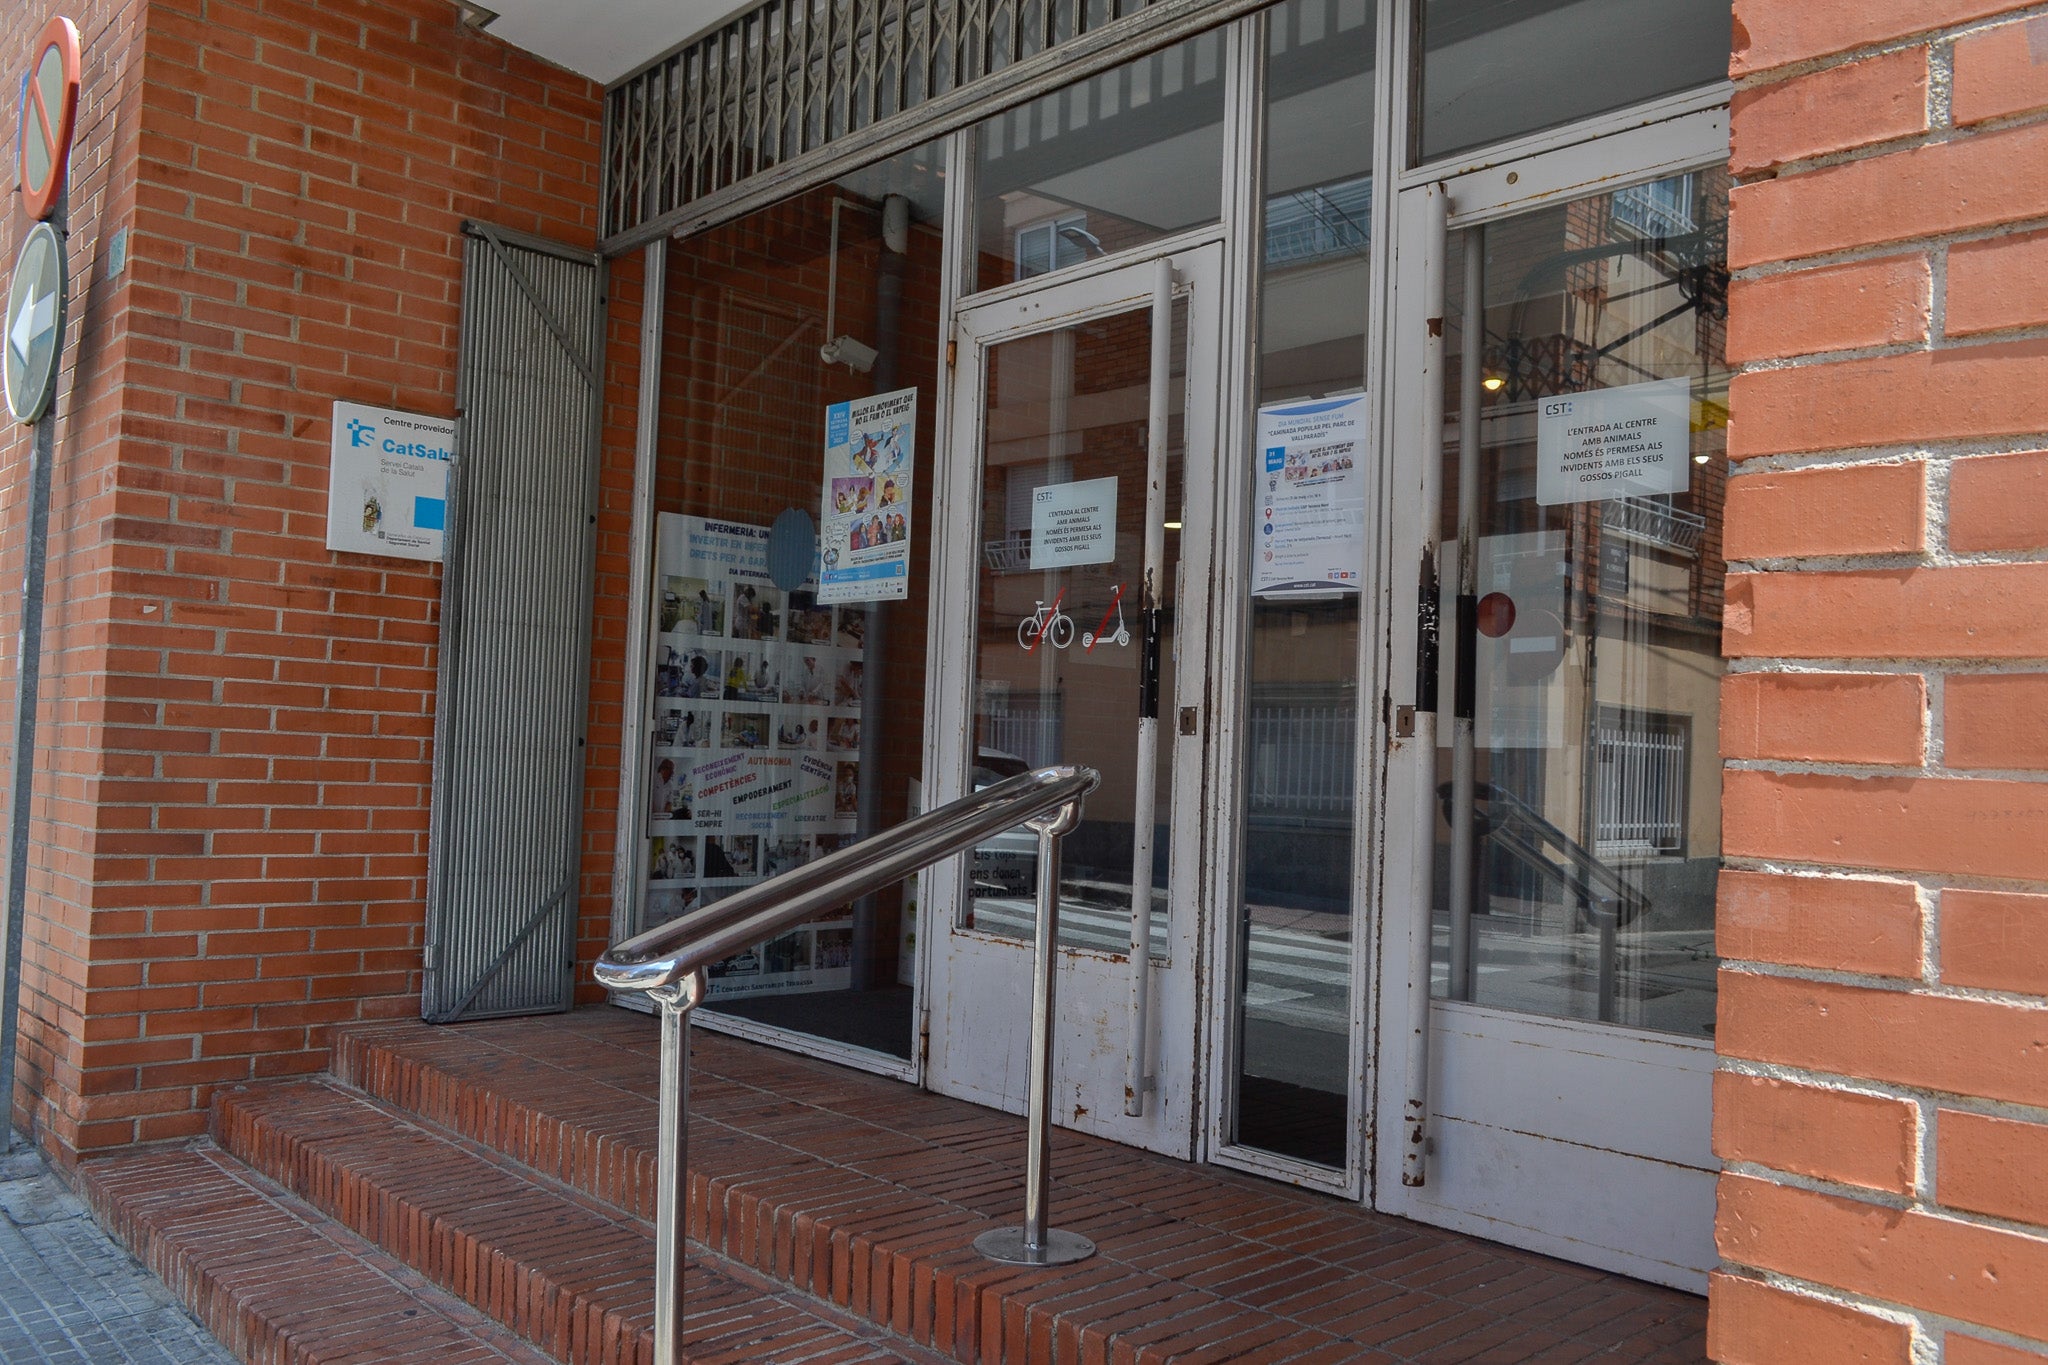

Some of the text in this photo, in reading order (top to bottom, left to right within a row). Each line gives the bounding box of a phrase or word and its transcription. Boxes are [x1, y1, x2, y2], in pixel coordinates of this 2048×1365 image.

[383, 416, 454, 435] Centre proveïdor
[1297, 423, 1321, 432] POPULAR
[1613, 422, 1624, 431] AL
[1625, 417, 1657, 429] CENTRE
[1582, 431, 1642, 447] AMB ANIMALS
[1563, 441, 1663, 461] NOMÉS ÉS PERMESA ALS
[380, 458, 402, 468] Servei
[1560, 453, 1664, 473] INVIDENTS AMB ELS SEUS
[398, 468, 416, 477] Salut
[1579, 468, 1643, 482] GOSSOS PIGALL
[1081, 505, 1099, 514] CENTRE
[1056, 516, 1090, 526] AMB ANIMALS
[704, 522, 757, 538] INFERMERIA:
[1046, 527, 1063, 536] NOMÉS
[1063, 526, 1069, 534] ÉS
[1070, 525, 1092, 533] PERMESA
[689, 534, 728, 548] INVERTIR
[731, 539, 742, 549] EN
[1043, 536, 1068, 545] INVIDENTS
[1055, 543, 1090, 553] GOSSOS PIGALL
[690, 549, 717, 561] DRETS
[719, 552, 737, 564] PER
[739, 554, 746, 565] A
[728, 568, 739, 576] DIA
[692, 752, 745, 775] RECONEIXEMENT
[747, 756, 791, 766] AUTONOMIA
[698, 773, 757, 799] COMPETÈNCIES
[732, 779, 792, 805] EMPODERAMENT
[697, 809, 722, 818] SER-HI
[695, 820, 723, 828] SEMPRE
[751, 821, 773, 829] SOCIAL
[970, 868, 990, 880] ens
